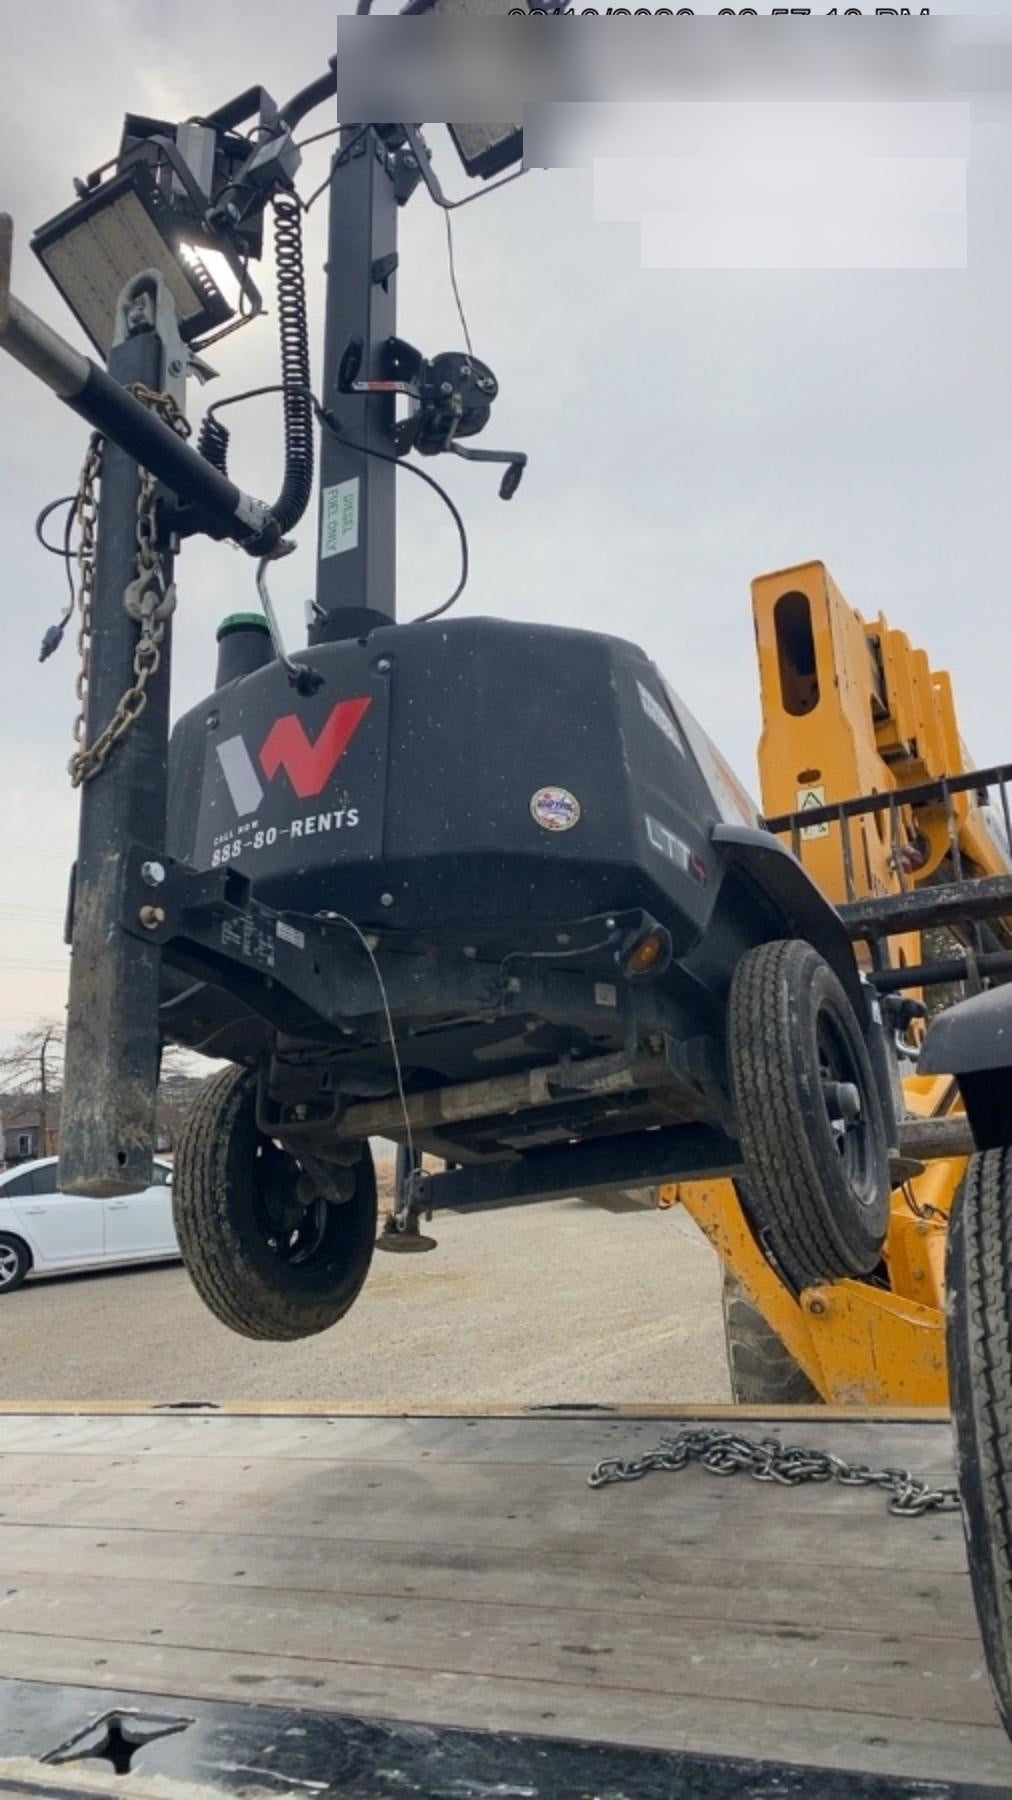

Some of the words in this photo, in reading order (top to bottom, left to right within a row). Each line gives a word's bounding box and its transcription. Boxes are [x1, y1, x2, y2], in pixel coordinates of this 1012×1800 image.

[327, 489, 338, 517] FUEL
[211, 809, 360, 867] 888-80-RENTS
[237, 820, 259, 834] NOW
